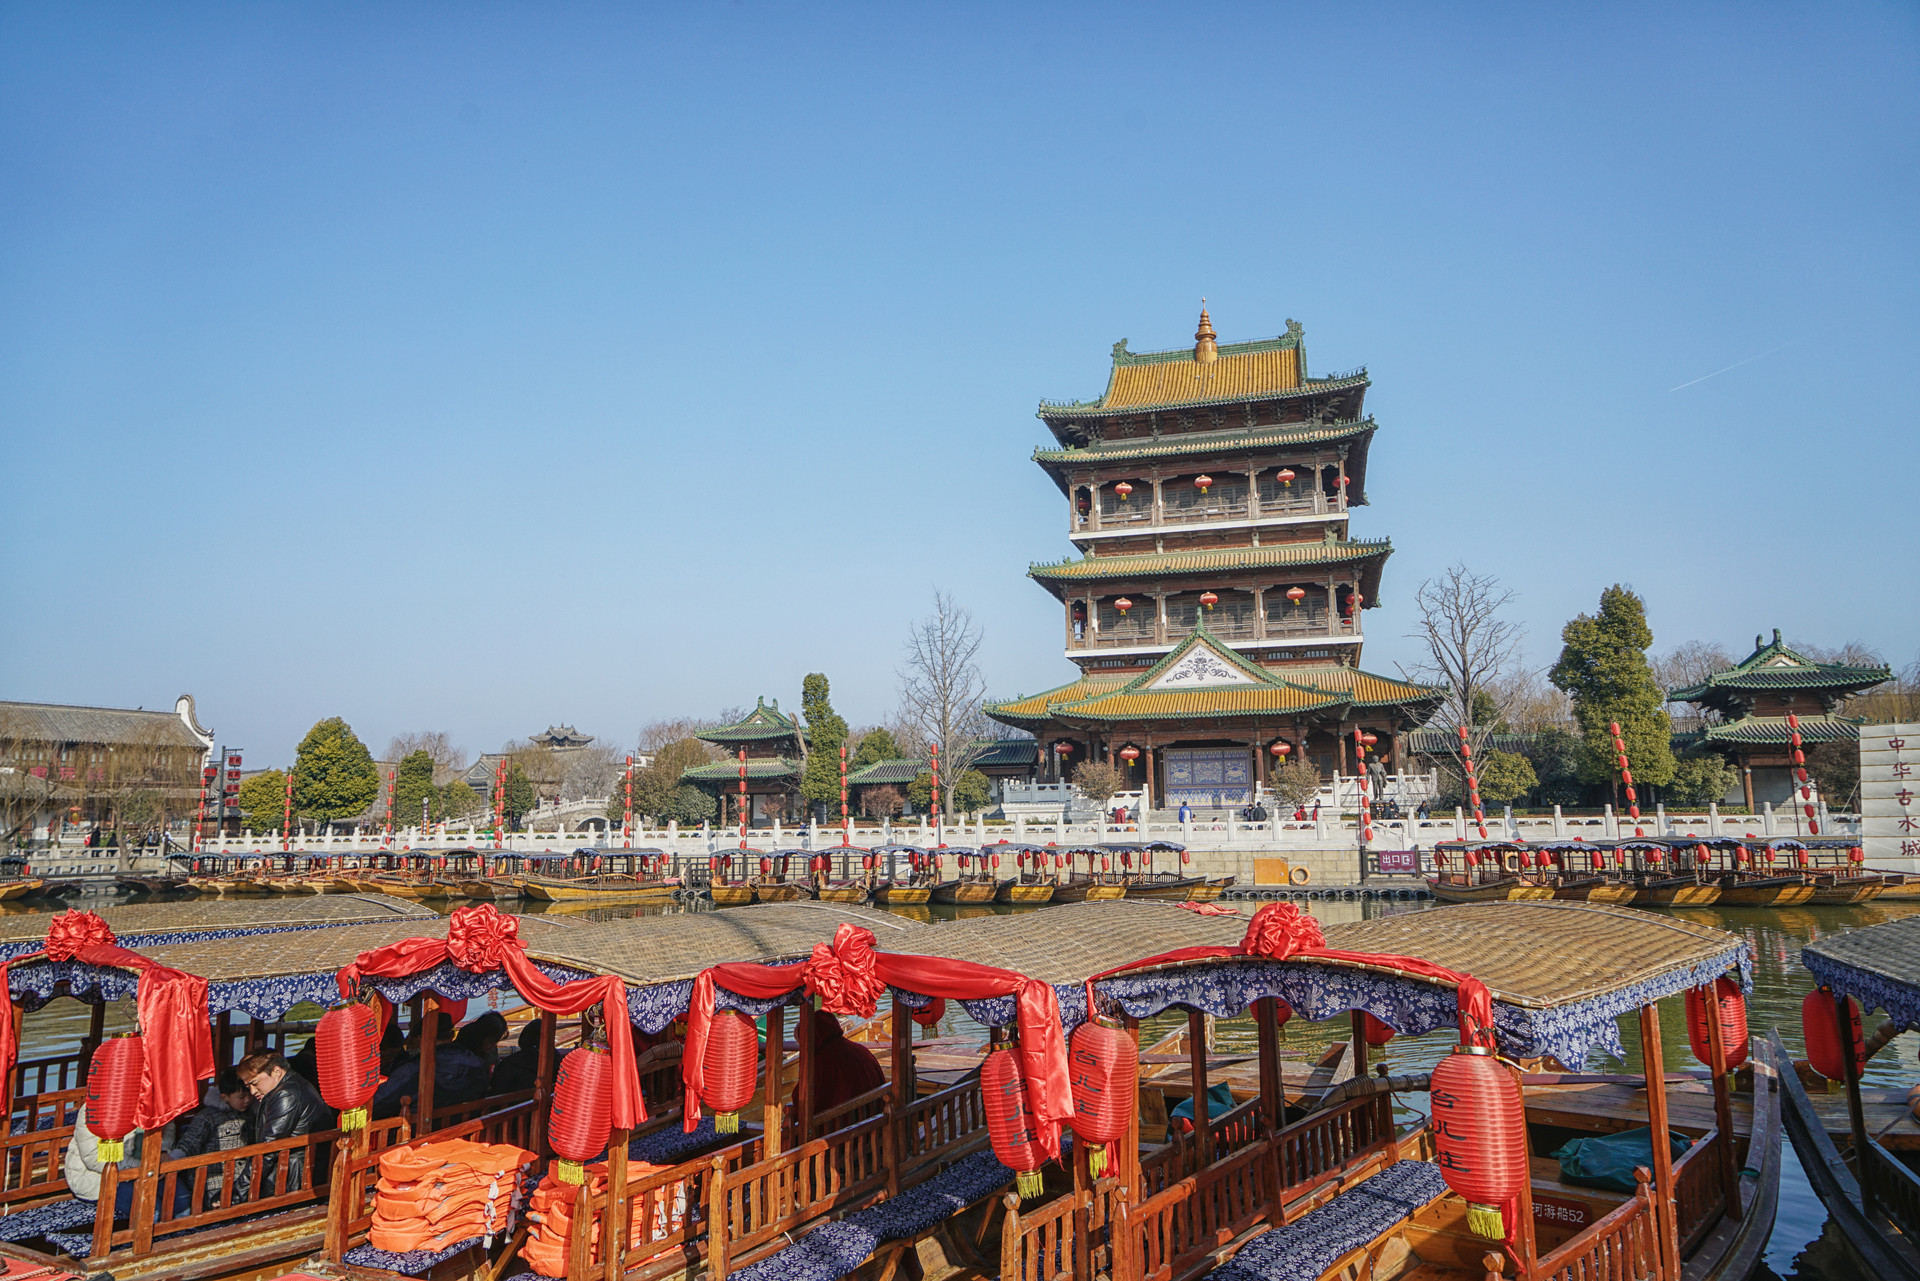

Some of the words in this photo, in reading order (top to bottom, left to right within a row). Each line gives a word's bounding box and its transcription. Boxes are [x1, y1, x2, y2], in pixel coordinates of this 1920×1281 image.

[1888, 737, 1920, 857] 中华古水城
[1382, 854, 1401, 864] 出口
[361, 1018, 381, 1087] 台儿庄
[1071, 1050, 1102, 1116] 台儿庄
[1000, 1078, 1039, 1146] 台儿庄
[1431, 1089, 1471, 1173] 台儿庄
